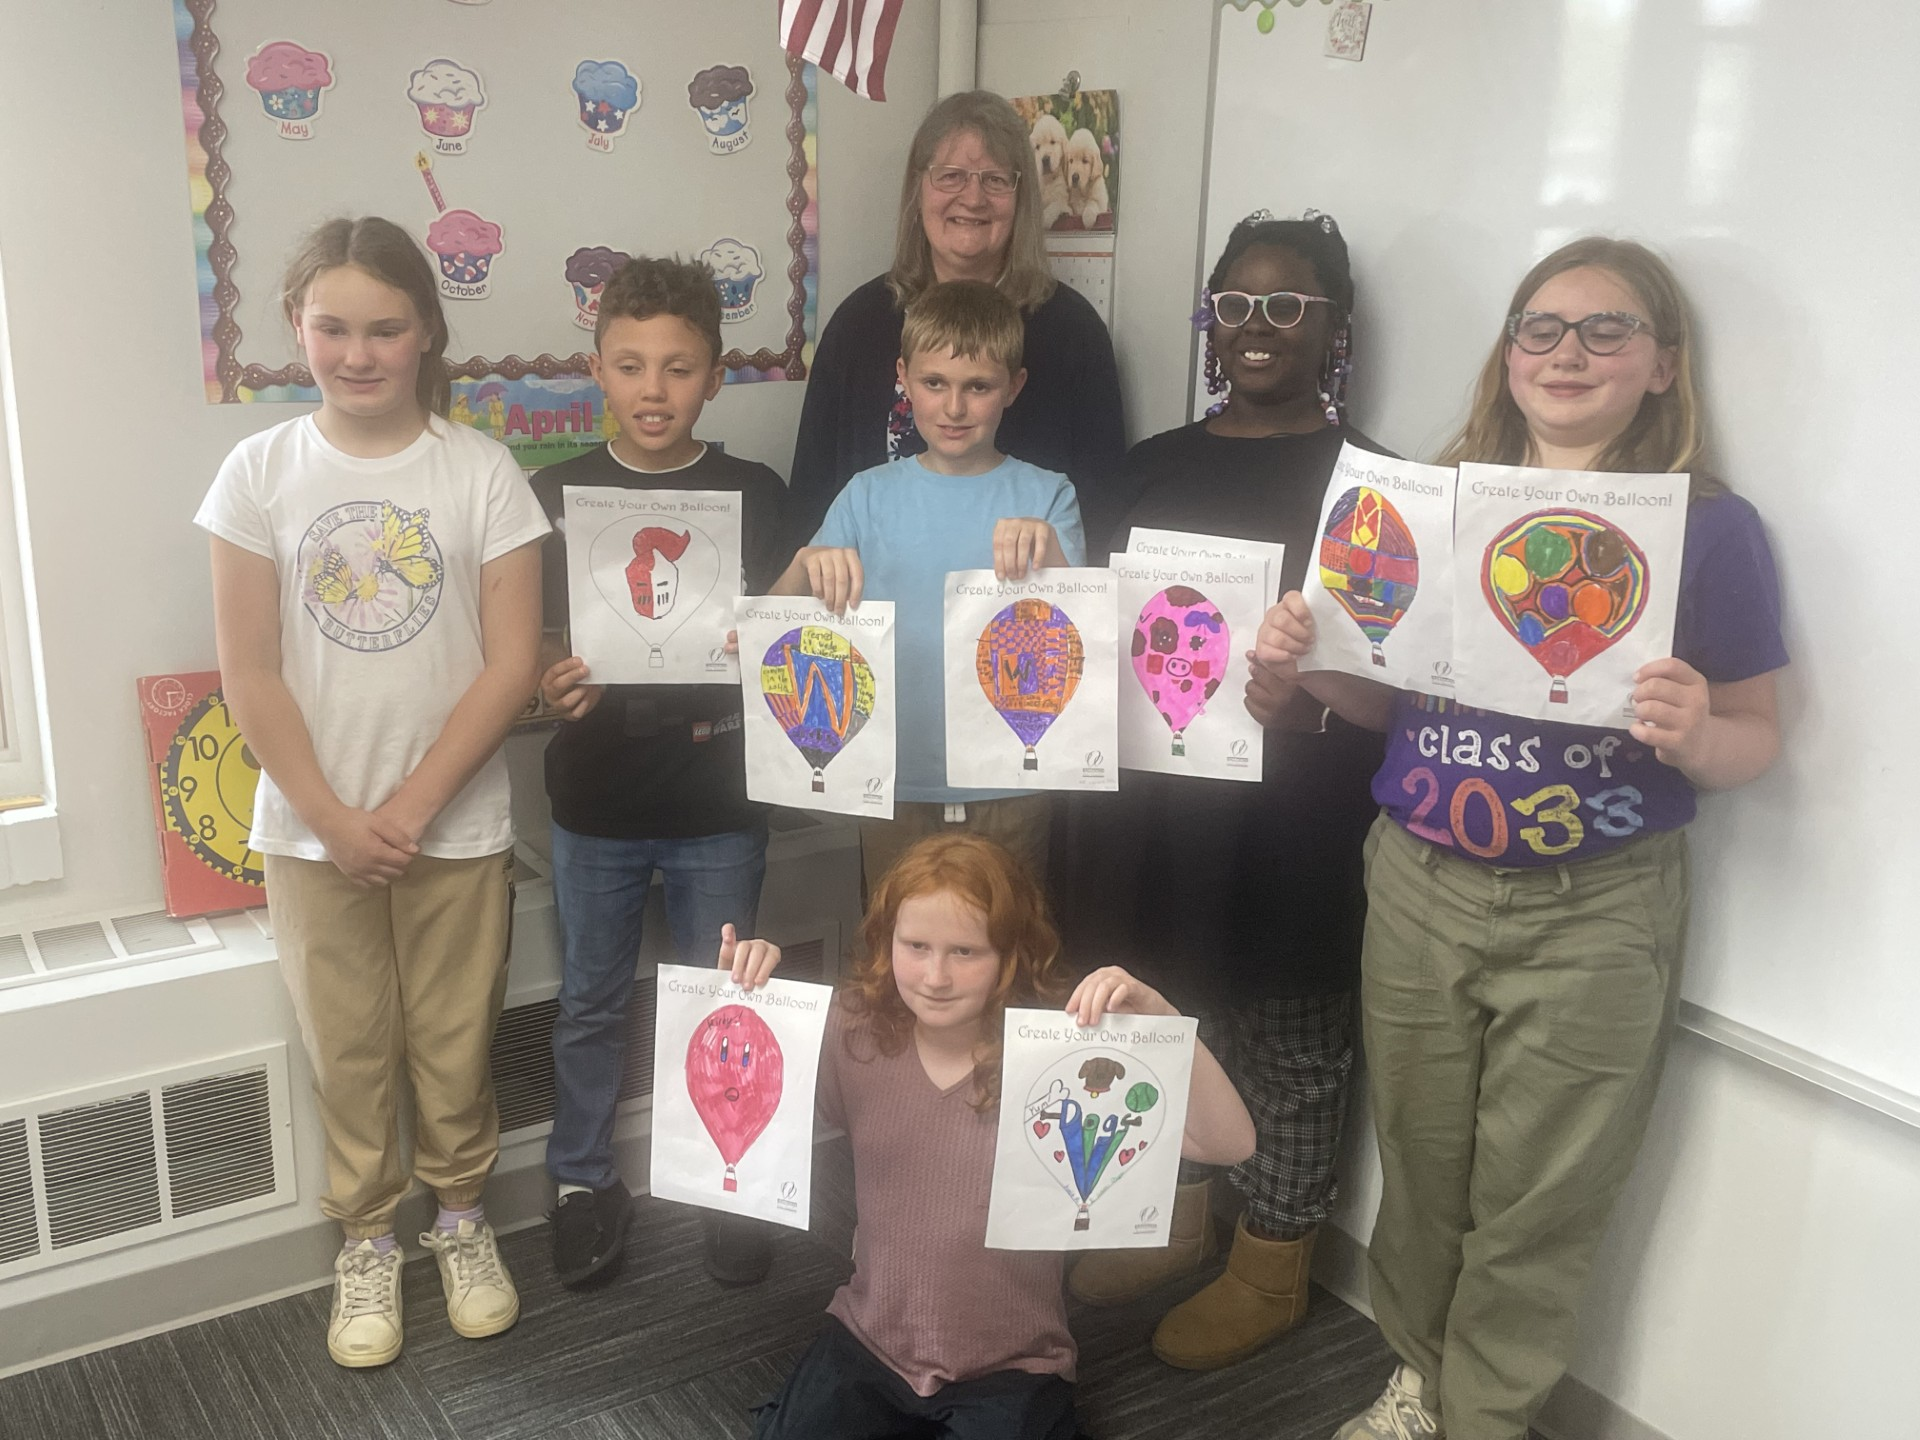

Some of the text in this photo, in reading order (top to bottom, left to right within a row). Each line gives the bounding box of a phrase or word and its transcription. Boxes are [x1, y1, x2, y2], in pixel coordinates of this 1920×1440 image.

[280, 121, 309, 138] May
[435, 138, 463, 152] June
[588, 133, 610, 150] July
[712, 131, 748, 151] August
[441, 280, 487, 297] October
[504, 401, 593, 441] April
[523, 443, 537, 451] you
[1366, 470, 1390, 488] Own
[1392, 476, 1443, 497] Balloon!
[1471, 481, 1673, 508] Create Your Own Balloon!
[576, 497, 731, 513] Create Your Own Balloon!
[308, 505, 378, 543] SAVE THE
[1136, 541, 1168, 556] Create
[1118, 567, 1254, 584] Create Your Own Balloon!
[956, 582, 1107, 598] Create Your Own Balloon!
[321, 595, 436, 650] BUTTERFLIES
[745, 607, 885, 628] Create Your Own Balloon!
[1004, 659, 1031, 682] W
[187, 734, 219, 761] 10
[1418, 725, 1622, 778] class of
[180, 776, 198, 802] 9
[1401, 766, 1644, 858] 2033
[199, 814, 217, 841] 8
[668, 979, 817, 1012] Create Your Own Balloon!
[1018, 1024, 1184, 1045] Create Your Own Balloon!
